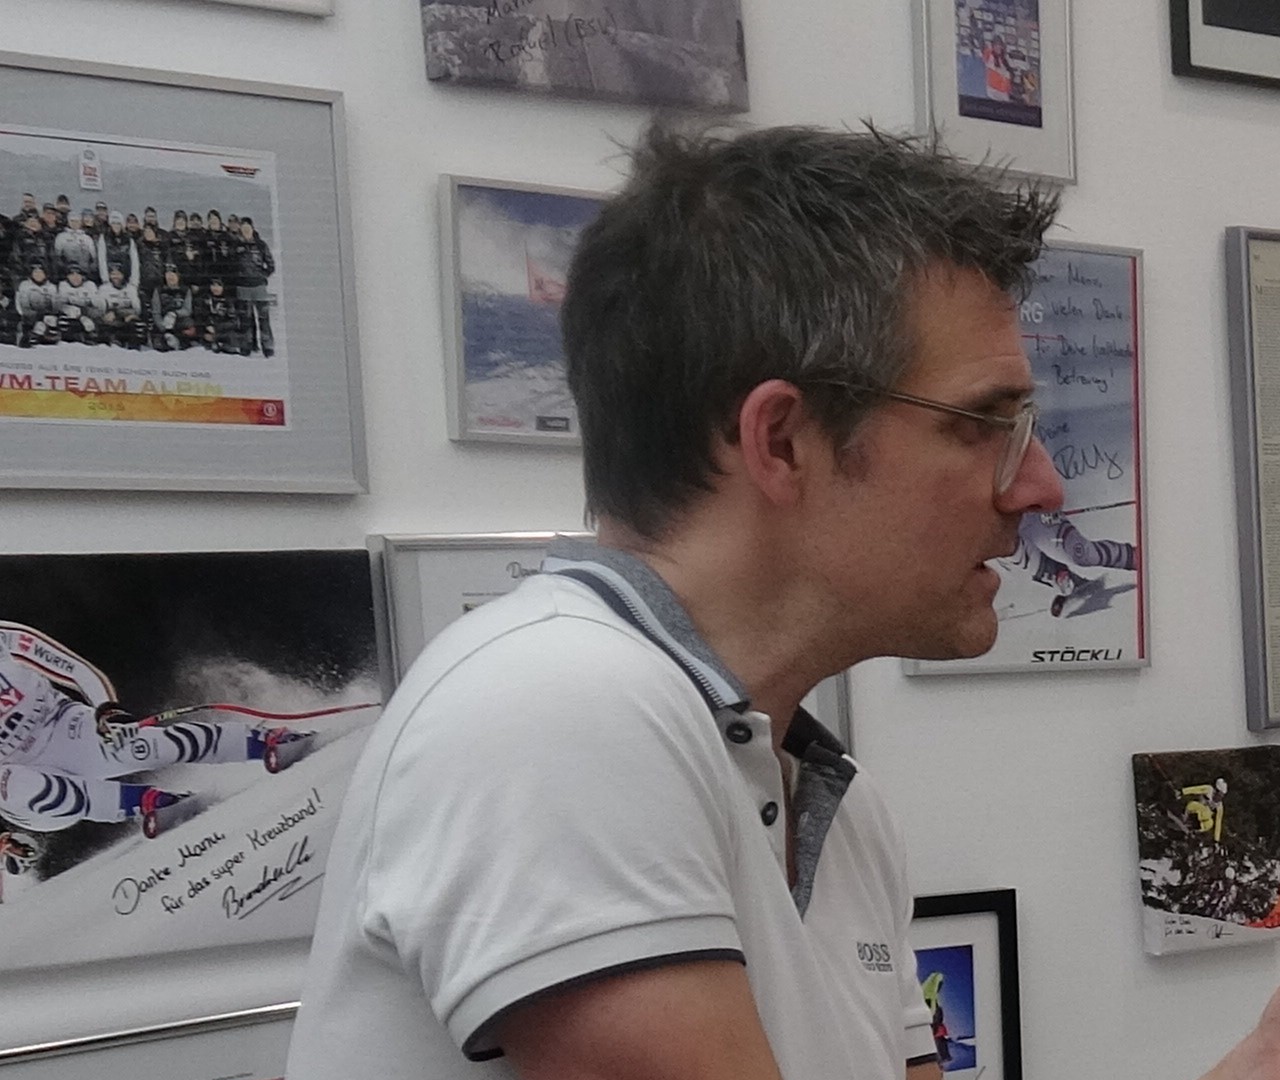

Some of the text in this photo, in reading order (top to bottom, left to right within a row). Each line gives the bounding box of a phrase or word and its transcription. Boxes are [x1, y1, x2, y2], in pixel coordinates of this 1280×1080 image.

[1019, 300, 1044, 323] RG
[1031, 646, 1123, 663] STÖCKLI
[160, 786, 326, 915] für das super Kreuzband!
[856, 941, 891, 963] BOSS
